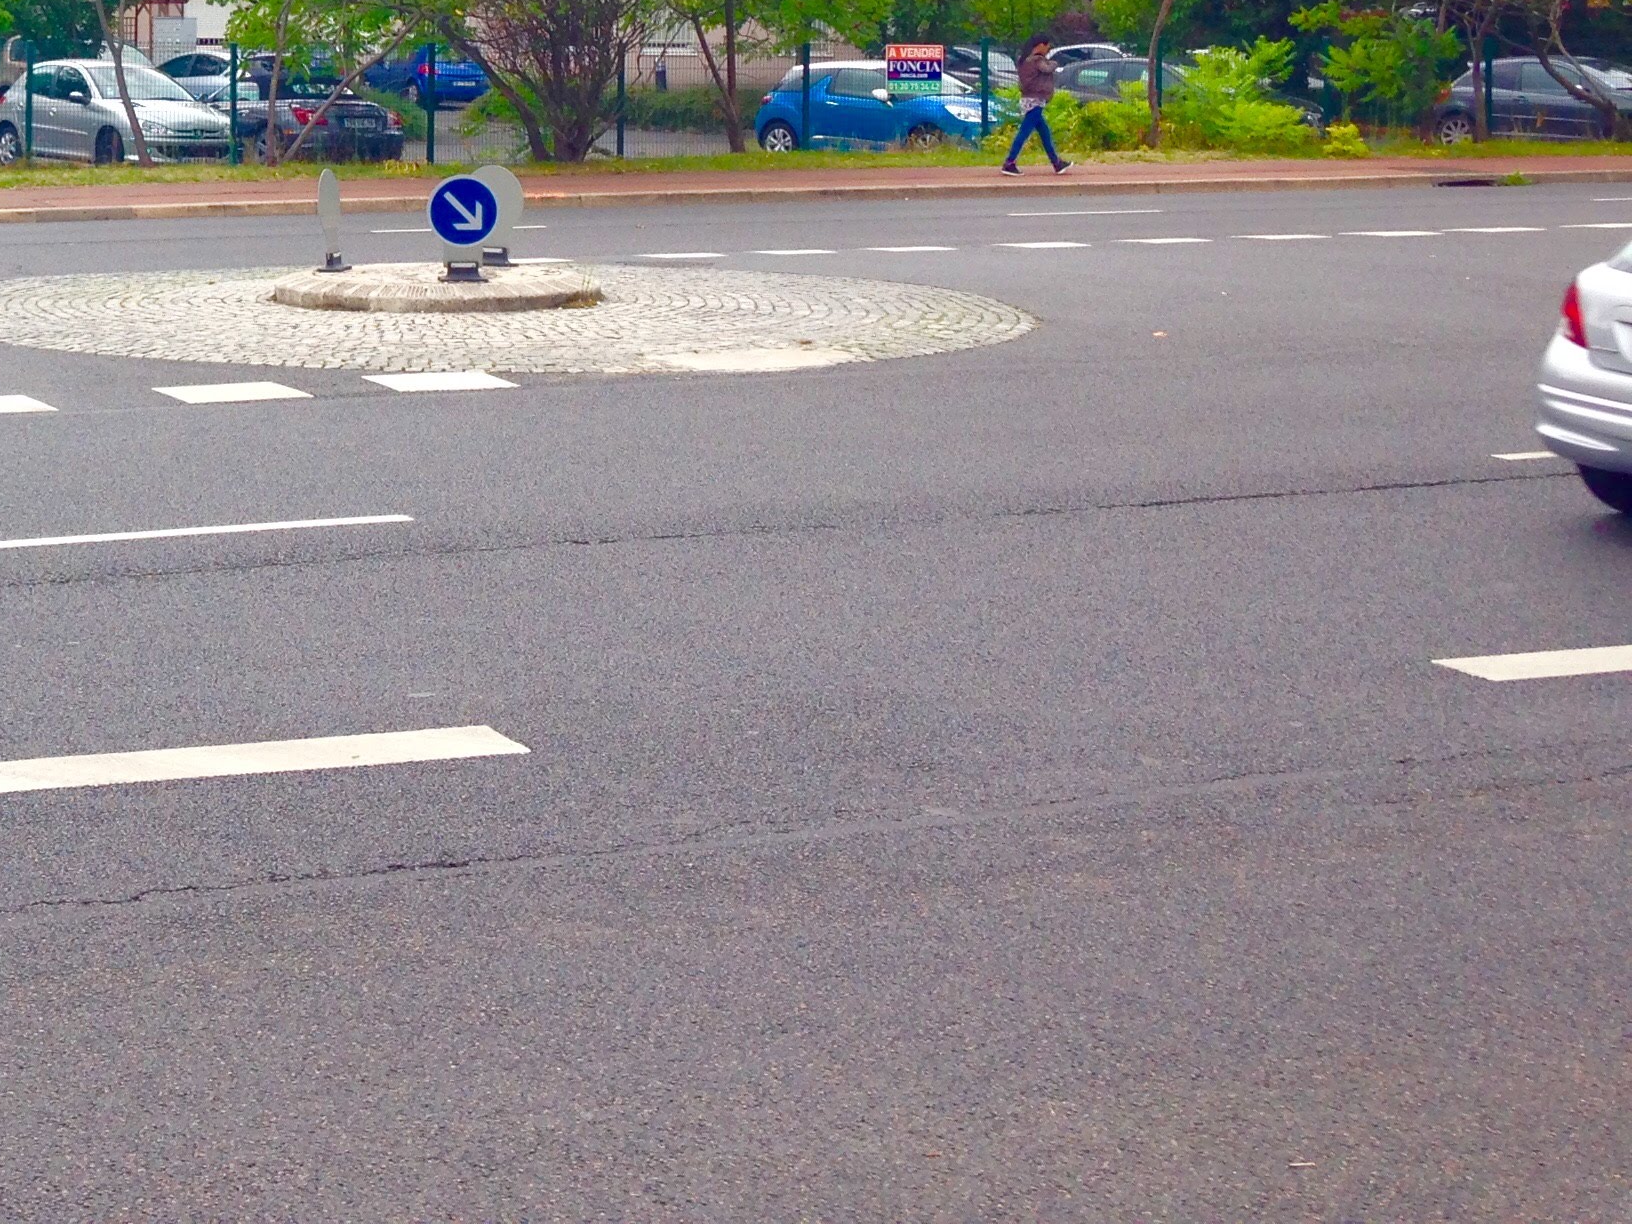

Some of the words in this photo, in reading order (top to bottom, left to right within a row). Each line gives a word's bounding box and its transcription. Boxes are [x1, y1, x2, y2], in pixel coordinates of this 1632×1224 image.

[888, 47, 897, 58] A
[899, 47, 942, 58] VENDRE
[889, 60, 941, 73] FONCIA
